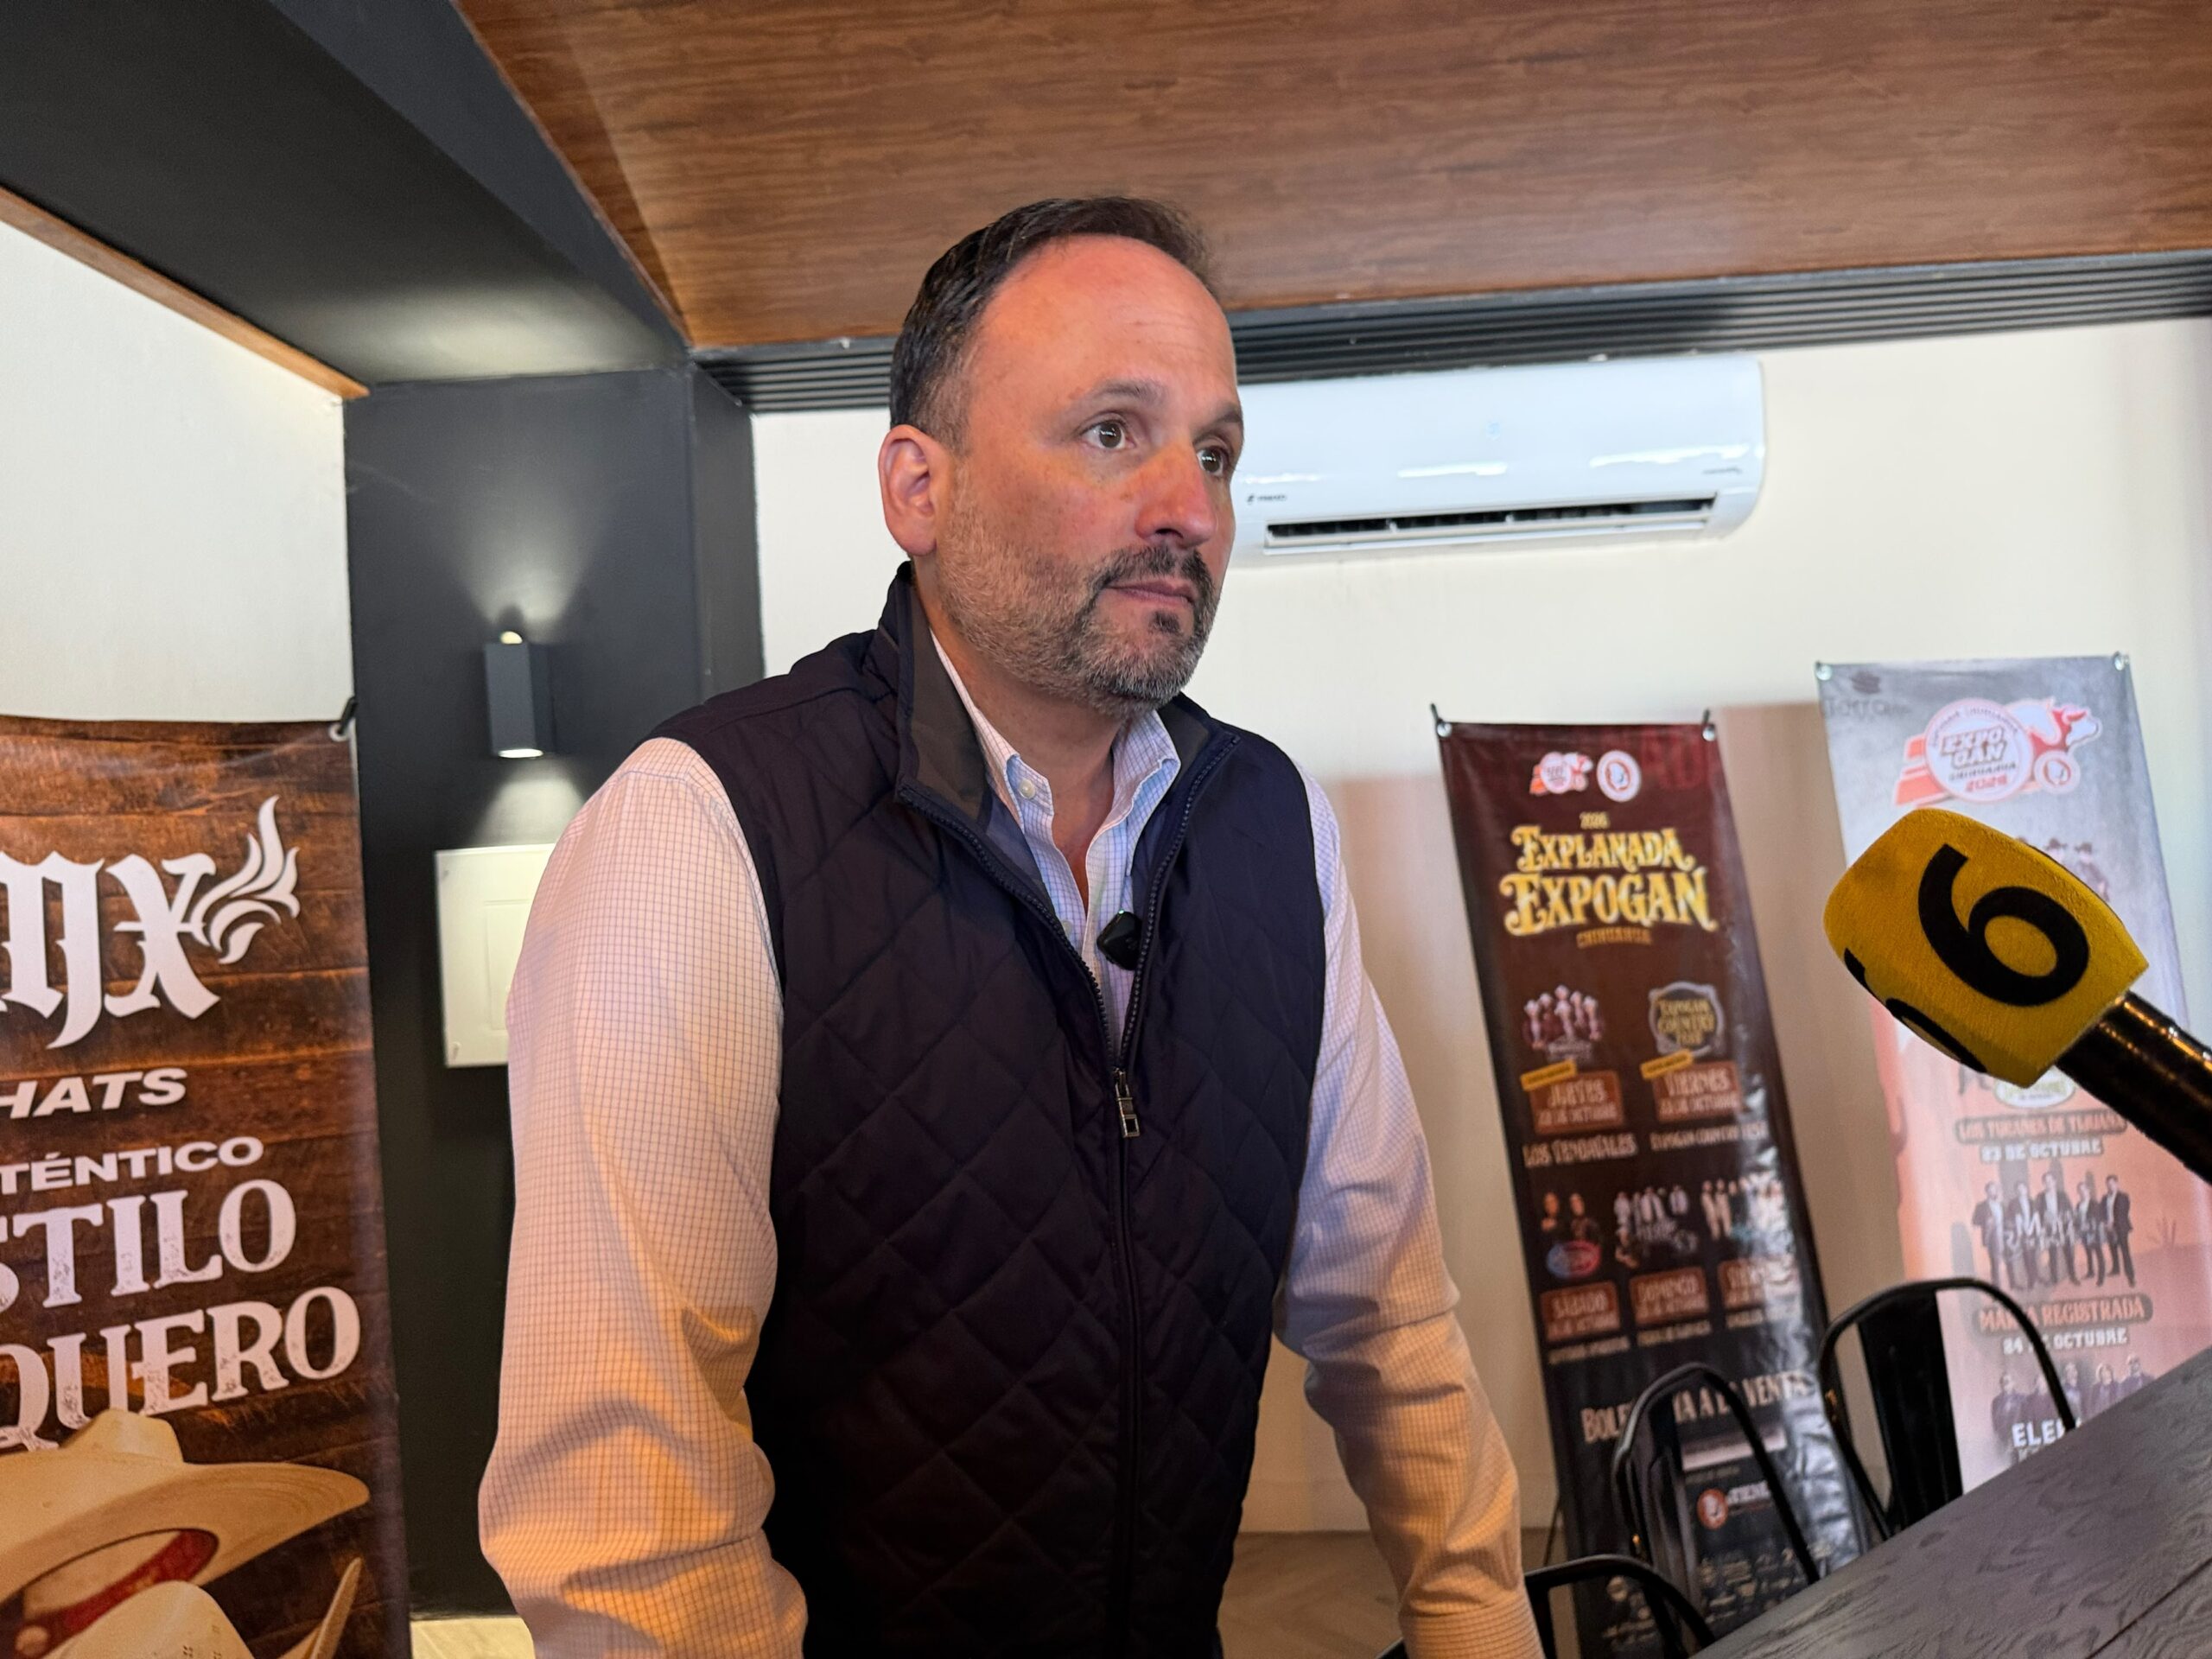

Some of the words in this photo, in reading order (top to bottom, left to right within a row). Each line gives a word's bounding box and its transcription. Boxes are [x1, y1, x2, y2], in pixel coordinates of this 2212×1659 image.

[1940, 725, 2005, 757] EXPO
[1951, 741, 2007, 770] GAN
[1510, 824, 1698, 874] EXPLANADA
[1499, 866, 1719, 937] EXPOGAN
[1917, 842, 2089, 1007] 6
[0, 1067, 188, 1119] HATS
[1980, 1305, 2040, 1332] MARA
[2041, 1296, 2145, 1327] REGISTRADA
[2053, 1327, 2127, 1351] OCTUBRE
